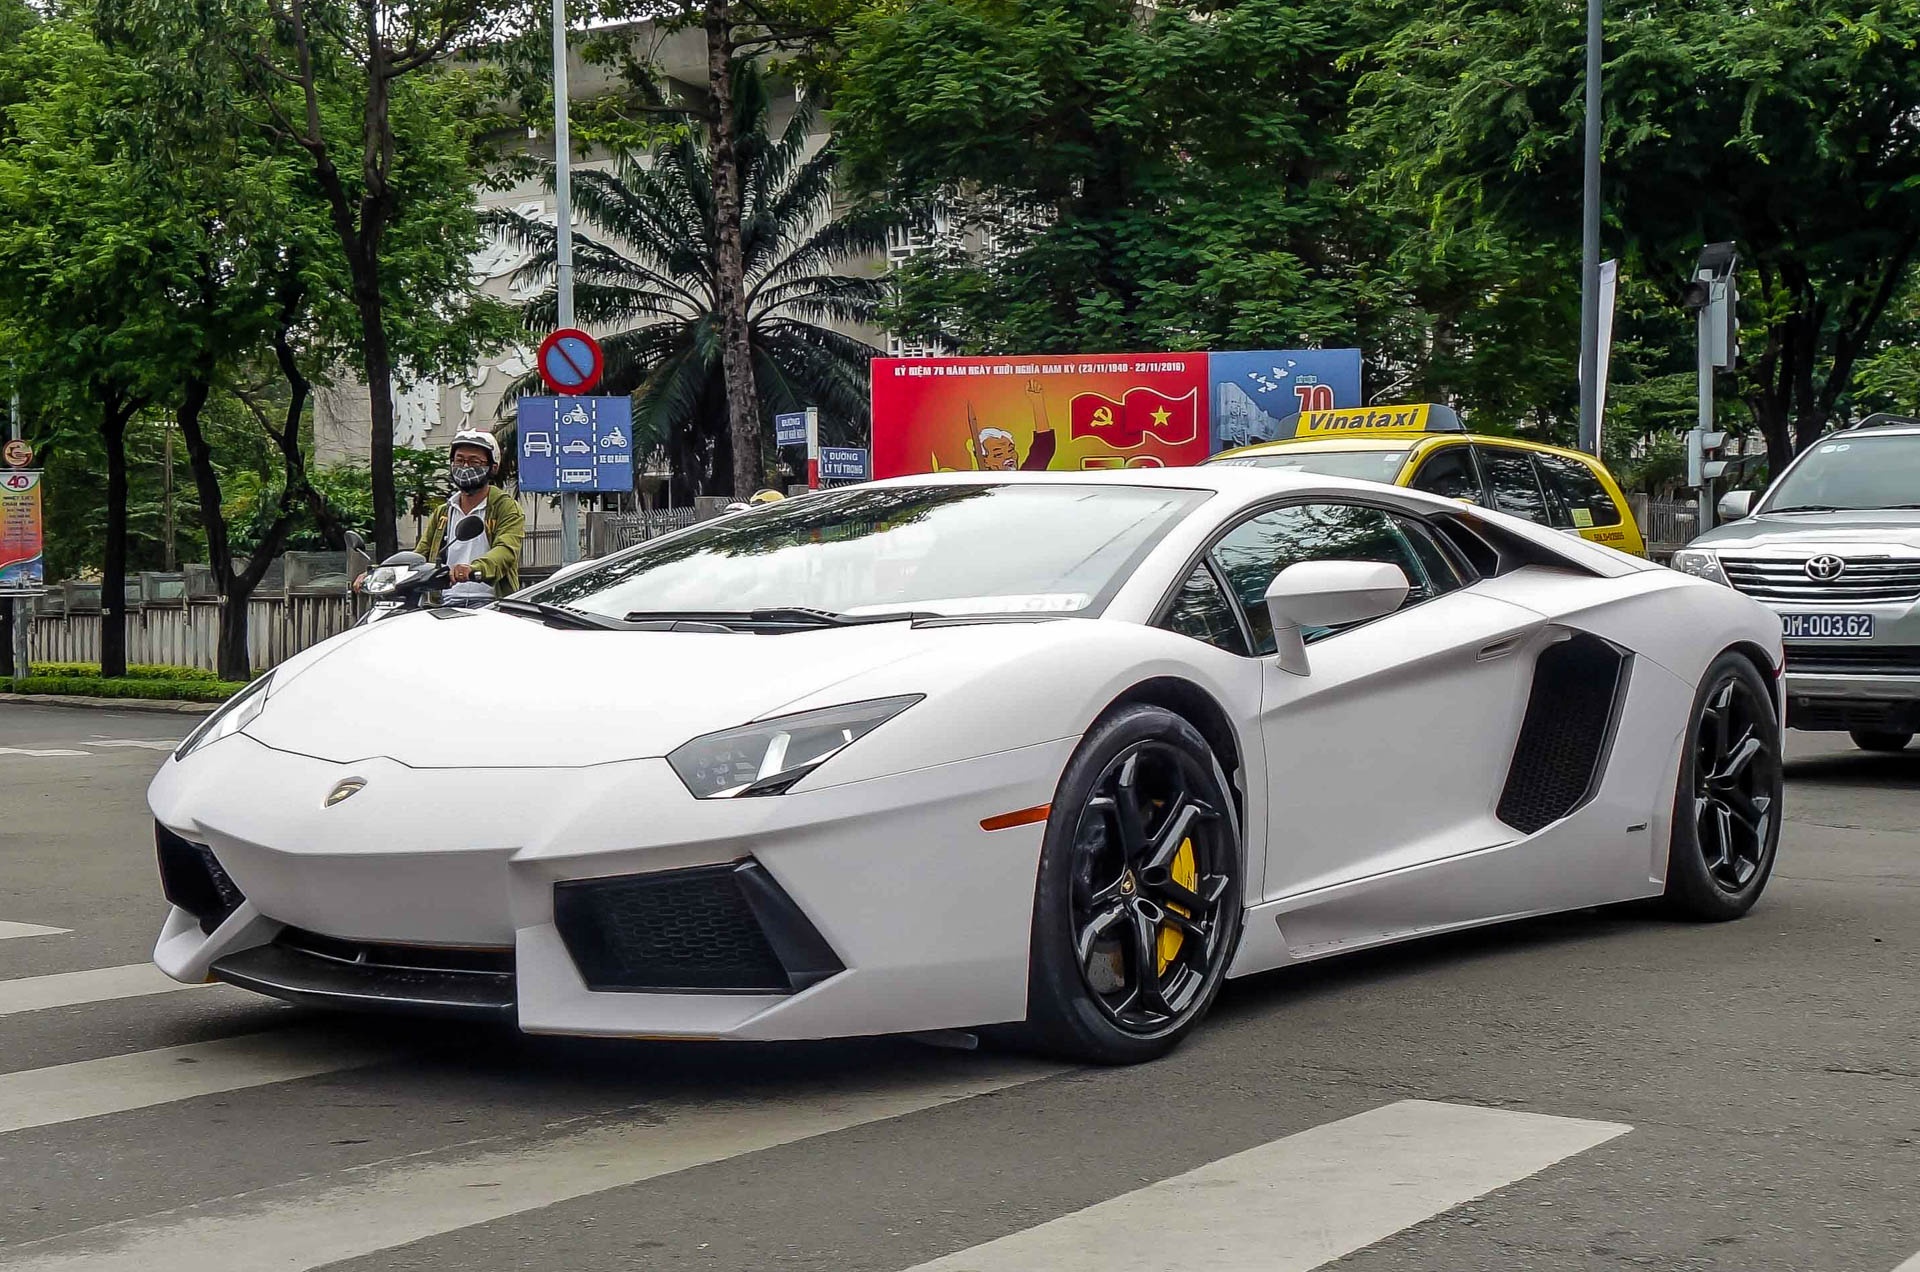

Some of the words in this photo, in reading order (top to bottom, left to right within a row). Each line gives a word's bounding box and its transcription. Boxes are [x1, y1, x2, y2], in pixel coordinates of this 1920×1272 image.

[1294, 386, 1333, 409] 70
[1309, 409, 1420, 430] Vinataxi
[829, 451, 858, 461] ĐƯỜNG
[824, 461, 832, 473] LÝ
[7, 475, 29, 488] 40
